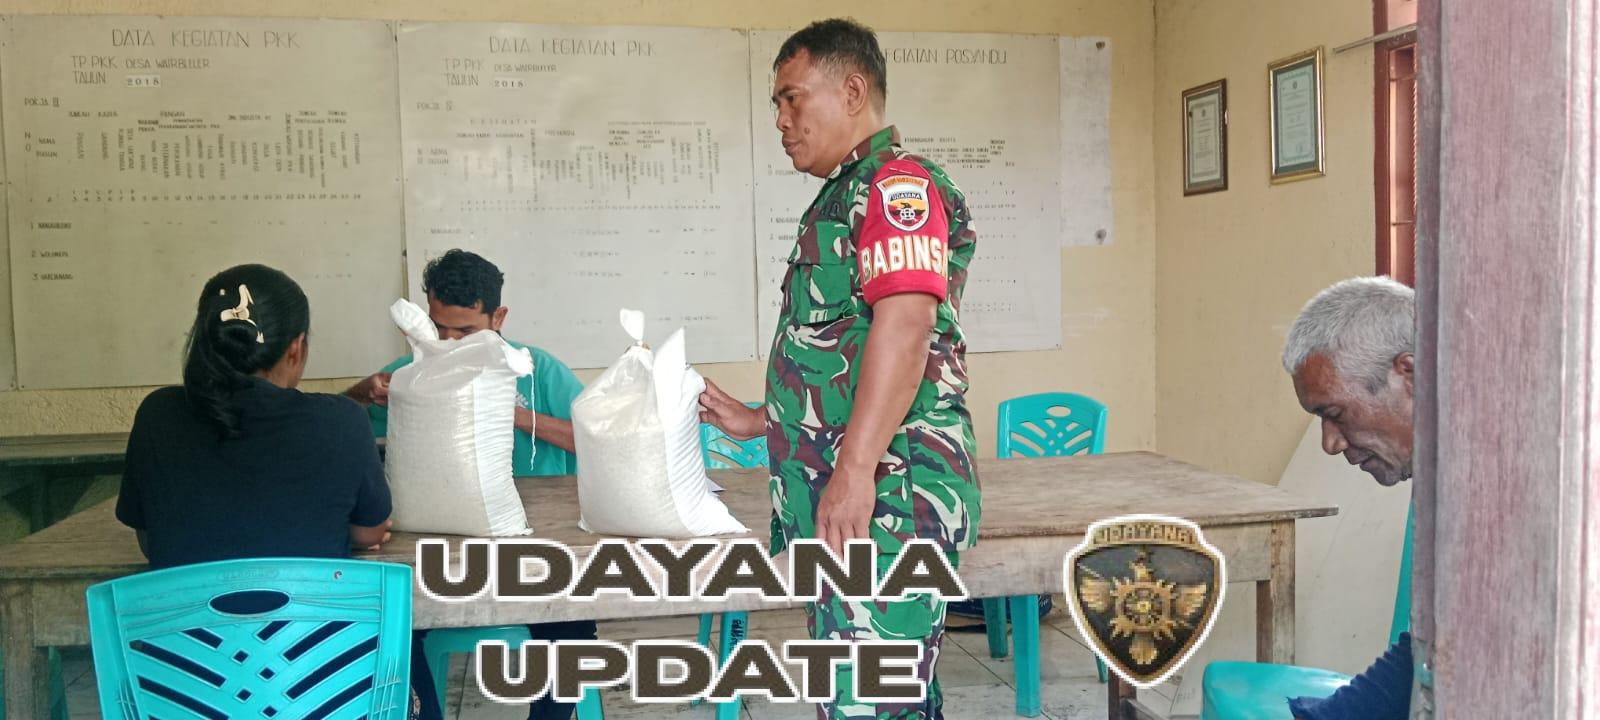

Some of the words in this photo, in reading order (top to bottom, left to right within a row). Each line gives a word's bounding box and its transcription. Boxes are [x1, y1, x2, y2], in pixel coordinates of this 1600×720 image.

[111, 29, 155, 46] DATA
[171, 30, 249, 48] KEGIATAN
[263, 31, 301, 48] PKK
[489, 36, 531, 54] DATA
[542, 39, 616, 57] KEGIATAN
[627, 40, 656, 57] PKK
[125, 59, 151, 69] DESA
[946, 48, 1008, 65] POSYANDU
[73, 71, 106, 84] TAHUN
[127, 77, 159, 86] 2018
